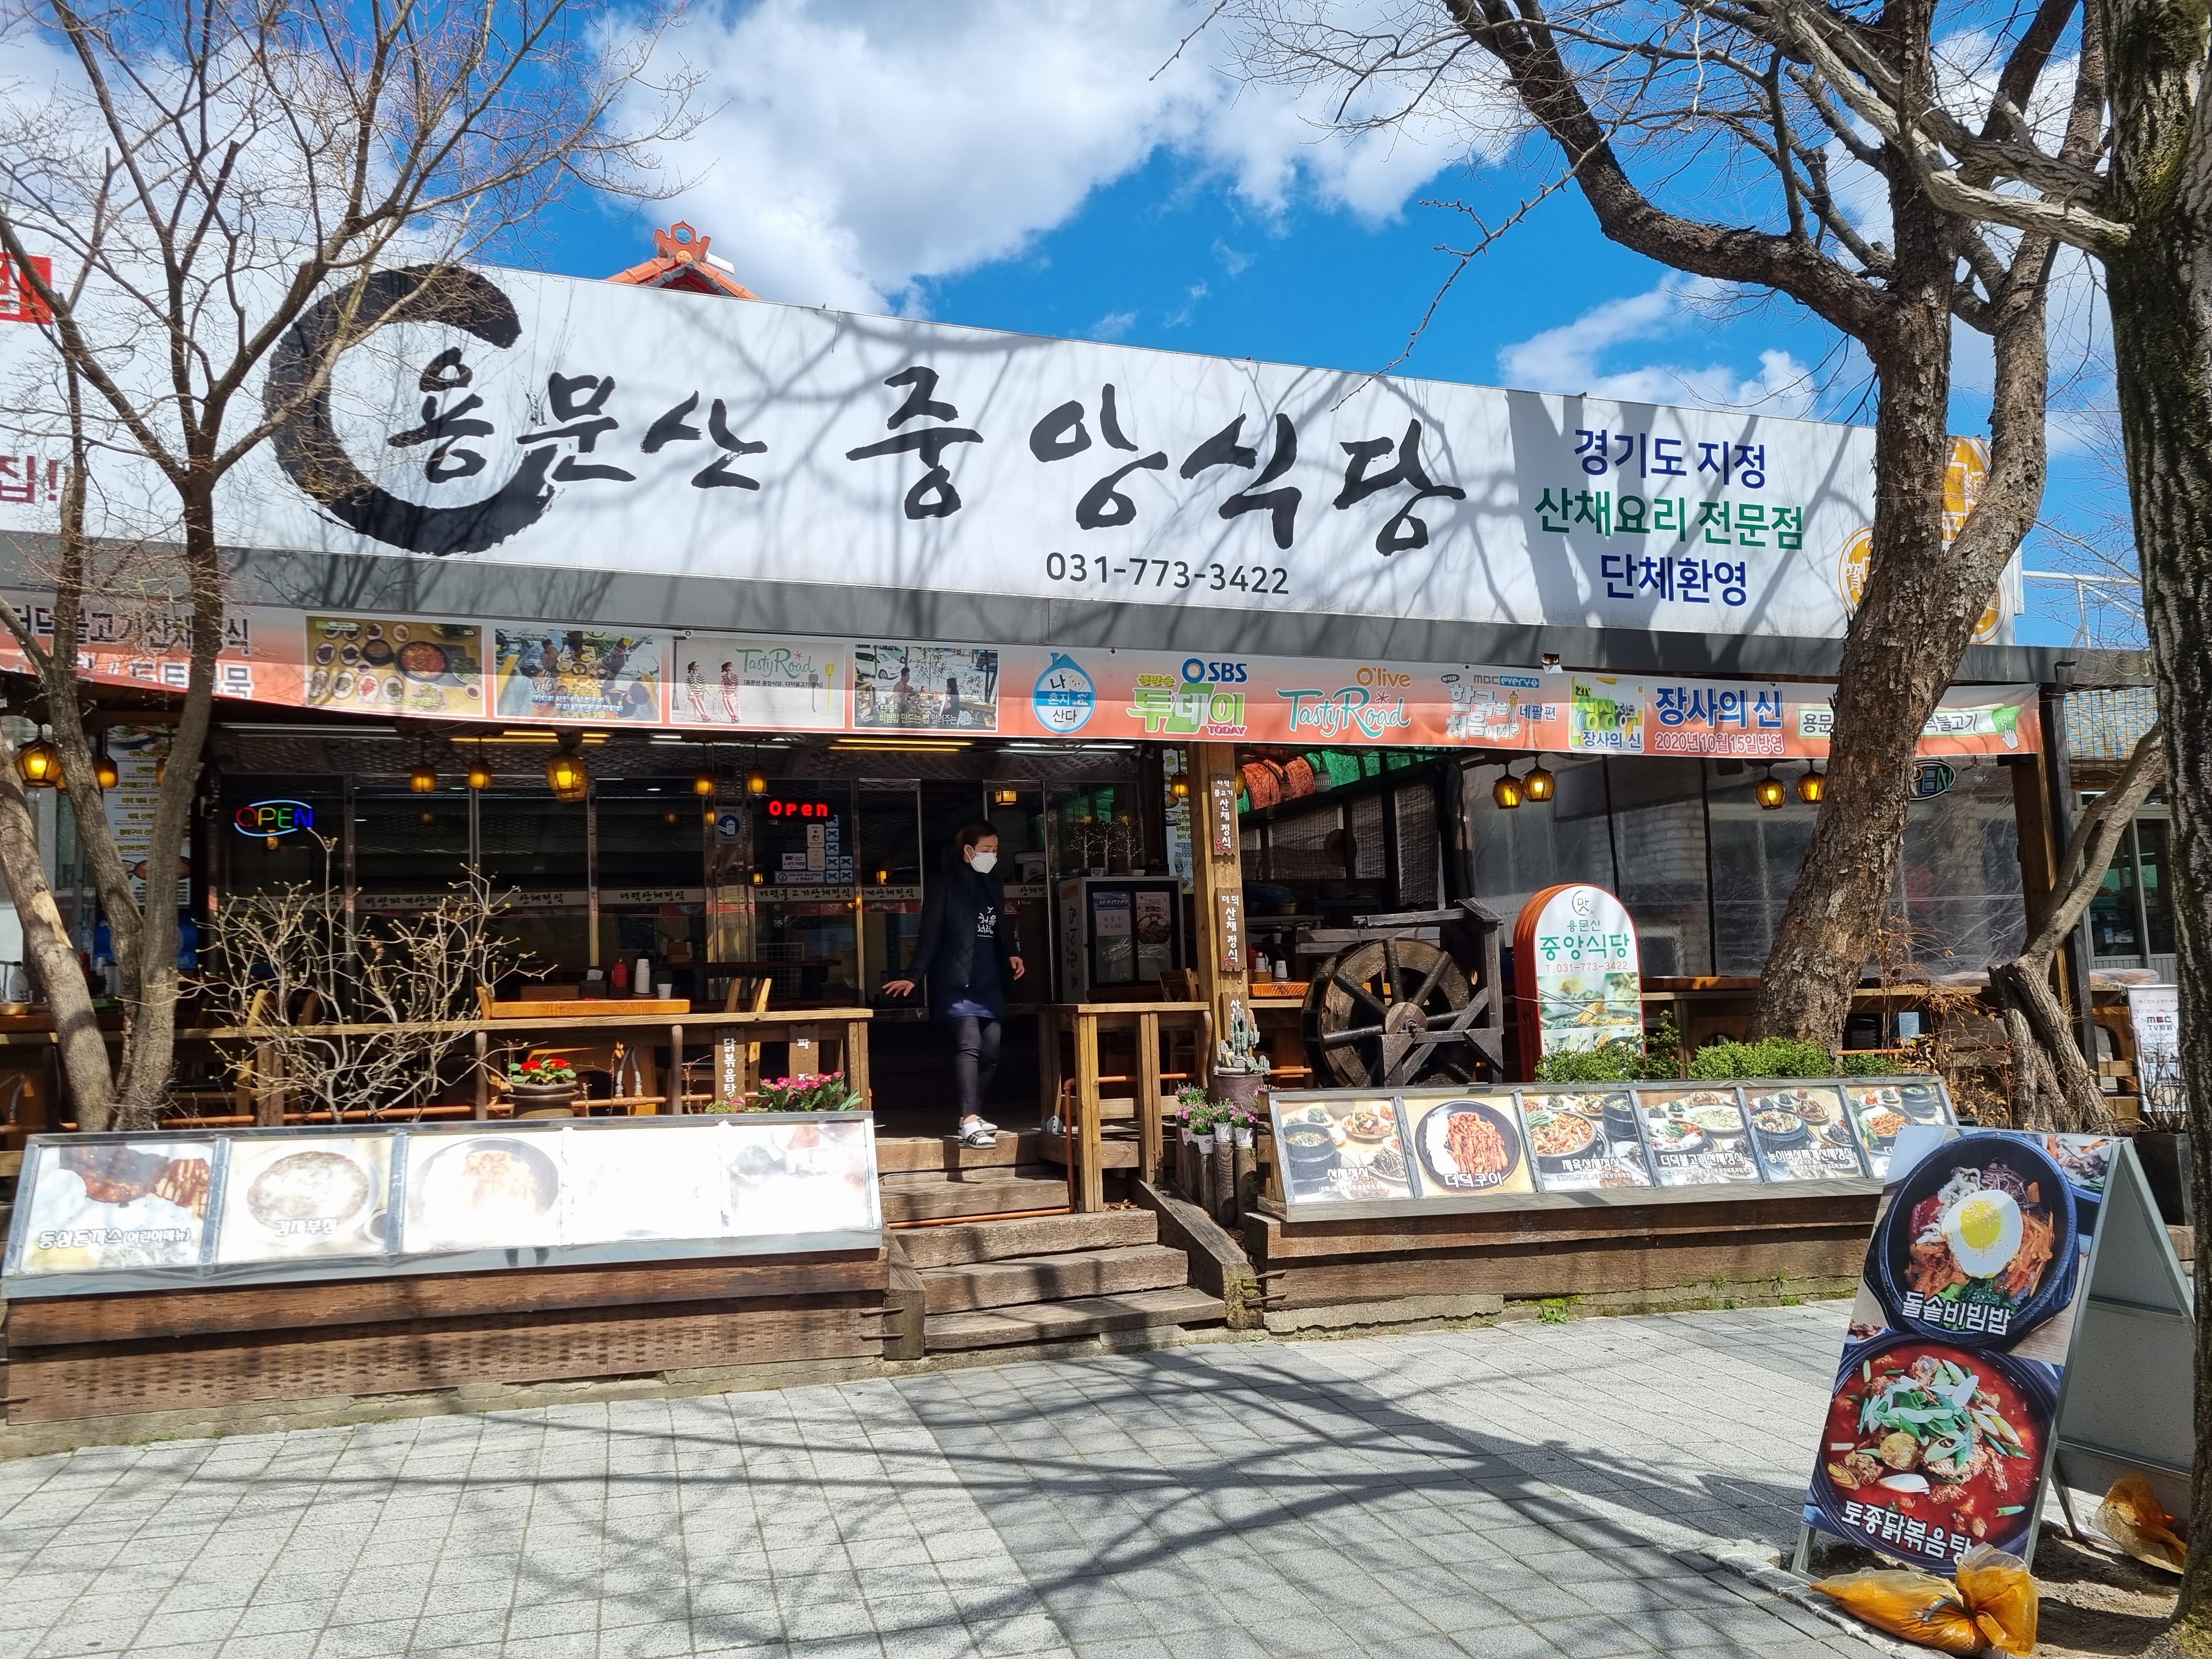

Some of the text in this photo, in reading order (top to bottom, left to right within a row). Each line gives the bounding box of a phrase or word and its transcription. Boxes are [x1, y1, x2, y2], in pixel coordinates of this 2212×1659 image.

[387, 346, 1467, 557] 용문산 중앙식당
[1573, 429, 1765, 489] 경기도 지정
[1534, 487, 1803, 550] 산채요리 전문점
[1045, 551, 1290, 595] 031-773-3422
[1600, 554, 1747, 607] 단체환영
[1049, 675, 1066, 690] 나
[1137, 674, 1177, 687] 생방송
[1207, 662, 1248, 683] SBS
[1047, 692, 1070, 706] 혼자
[1449, 684, 1509, 718] 한국은
[1655, 686, 1783, 729] 장사의 신
[879, 713, 900, 723] 비빔밥
[901, 713, 921, 724] 만드는
[923, 713, 929, 724] 법
[931, 714, 957, 725] 알려주는
[1052, 709, 1077, 724] 산다
[1126, 687, 1245, 733] 투데이
[1207, 725, 1247, 736] TODAY
[1446, 713, 1521, 741] 처음이지?
[1803, 714, 1832, 733] 용문
[1583, 731, 1641, 748] 장사의 신
[1655, 732, 1784, 754] 2020년 10월 15일 방영
[1214, 789, 1233, 797] 불고기
[235, 806, 314, 828] OPEN
[1220, 799, 1231, 849] 산채 정식
[519, 893, 564, 905] 산채정식
[1020, 886, 1047, 896] 산채정
[1221, 895, 1239, 906] 더덕
[1577, 897, 1590, 913] 맛
[1226, 907, 1238, 963] 산채 정식
[1567, 919, 1601, 933] 용문산
[1539, 933, 1630, 961] 중앙식당
[723, 1037, 736, 1097] 닭볶음탕
[797, 1039, 810, 1081] 파
[1660, 1152, 1746, 1167] 더덕불고기산채정식
[1767, 1147, 1855, 1164] 능이버섯찌개산채정식
[1883, 1146, 1894, 1156] 더
[1561, 1157, 1623, 1172] 제육산채정식
[1444, 1171, 1505, 1189] 더덕구이
[1901, 1291, 2012, 1336] 돌솥비빔밥
[1841, 1500, 1973, 1566] 토종닭볶음탕
